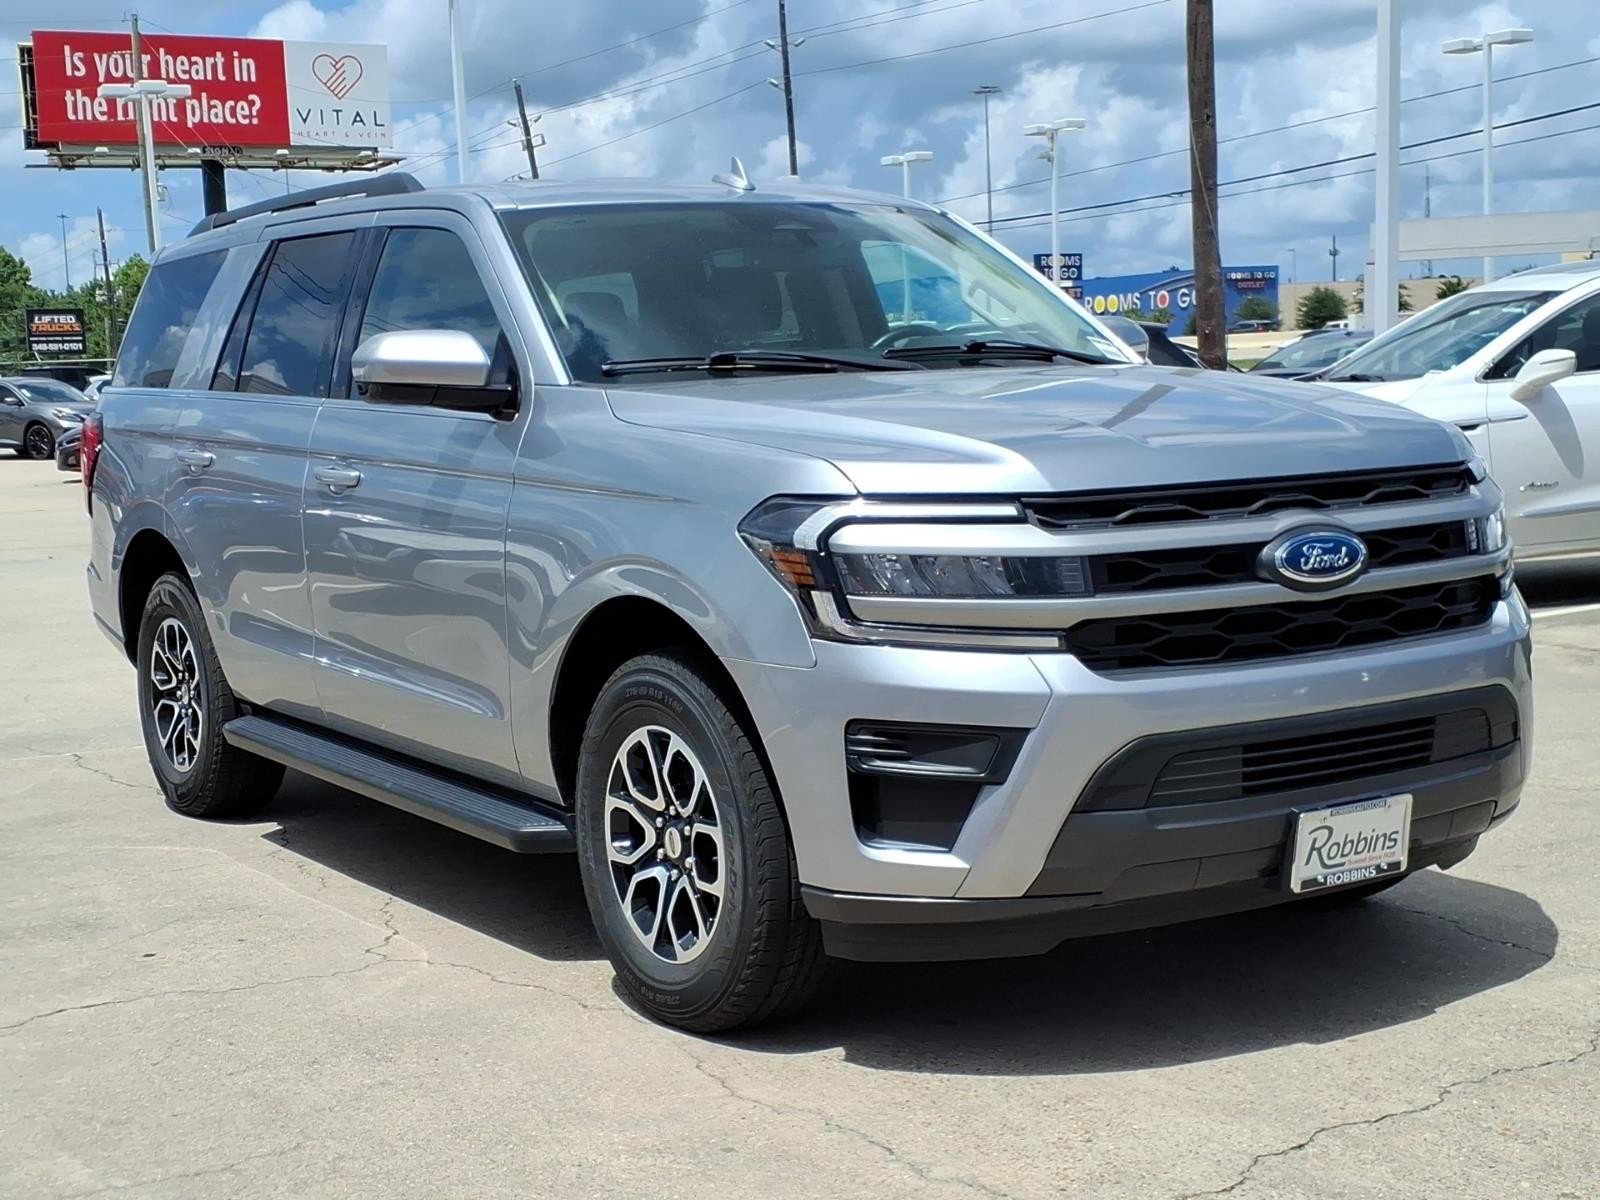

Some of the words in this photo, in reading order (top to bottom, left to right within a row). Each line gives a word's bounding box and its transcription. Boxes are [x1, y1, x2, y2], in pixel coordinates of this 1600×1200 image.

[63, 44, 86, 77] Is
[93, 51, 151, 83] your
[159, 47, 226, 81] heart
[233, 50, 257, 82] in
[64, 88, 108, 121] the
[116, 95, 178, 122] riht
[185, 92, 261, 128] place?
[296, 108, 385, 127] VITAL
[358, 131, 386, 139] VEIN
[1040, 255, 1081, 267] ROOMS
[1060, 268, 1078, 279] GO
[1253, 271, 1262, 279] TO
[1264, 271, 1276, 279] GO
[1237, 281, 1265, 289] OUTLET
[1084, 292, 1140, 314] ROOMS
[1149, 290, 1169, 310] TO
[34, 315, 76, 323] LIFTED
[31, 323, 82, 332] TRUCKS
[1300, 542, 1349, 570] Ford
[1304, 825, 1399, 870] Robbins
[1327, 866, 1377, 885] ROBBINS
